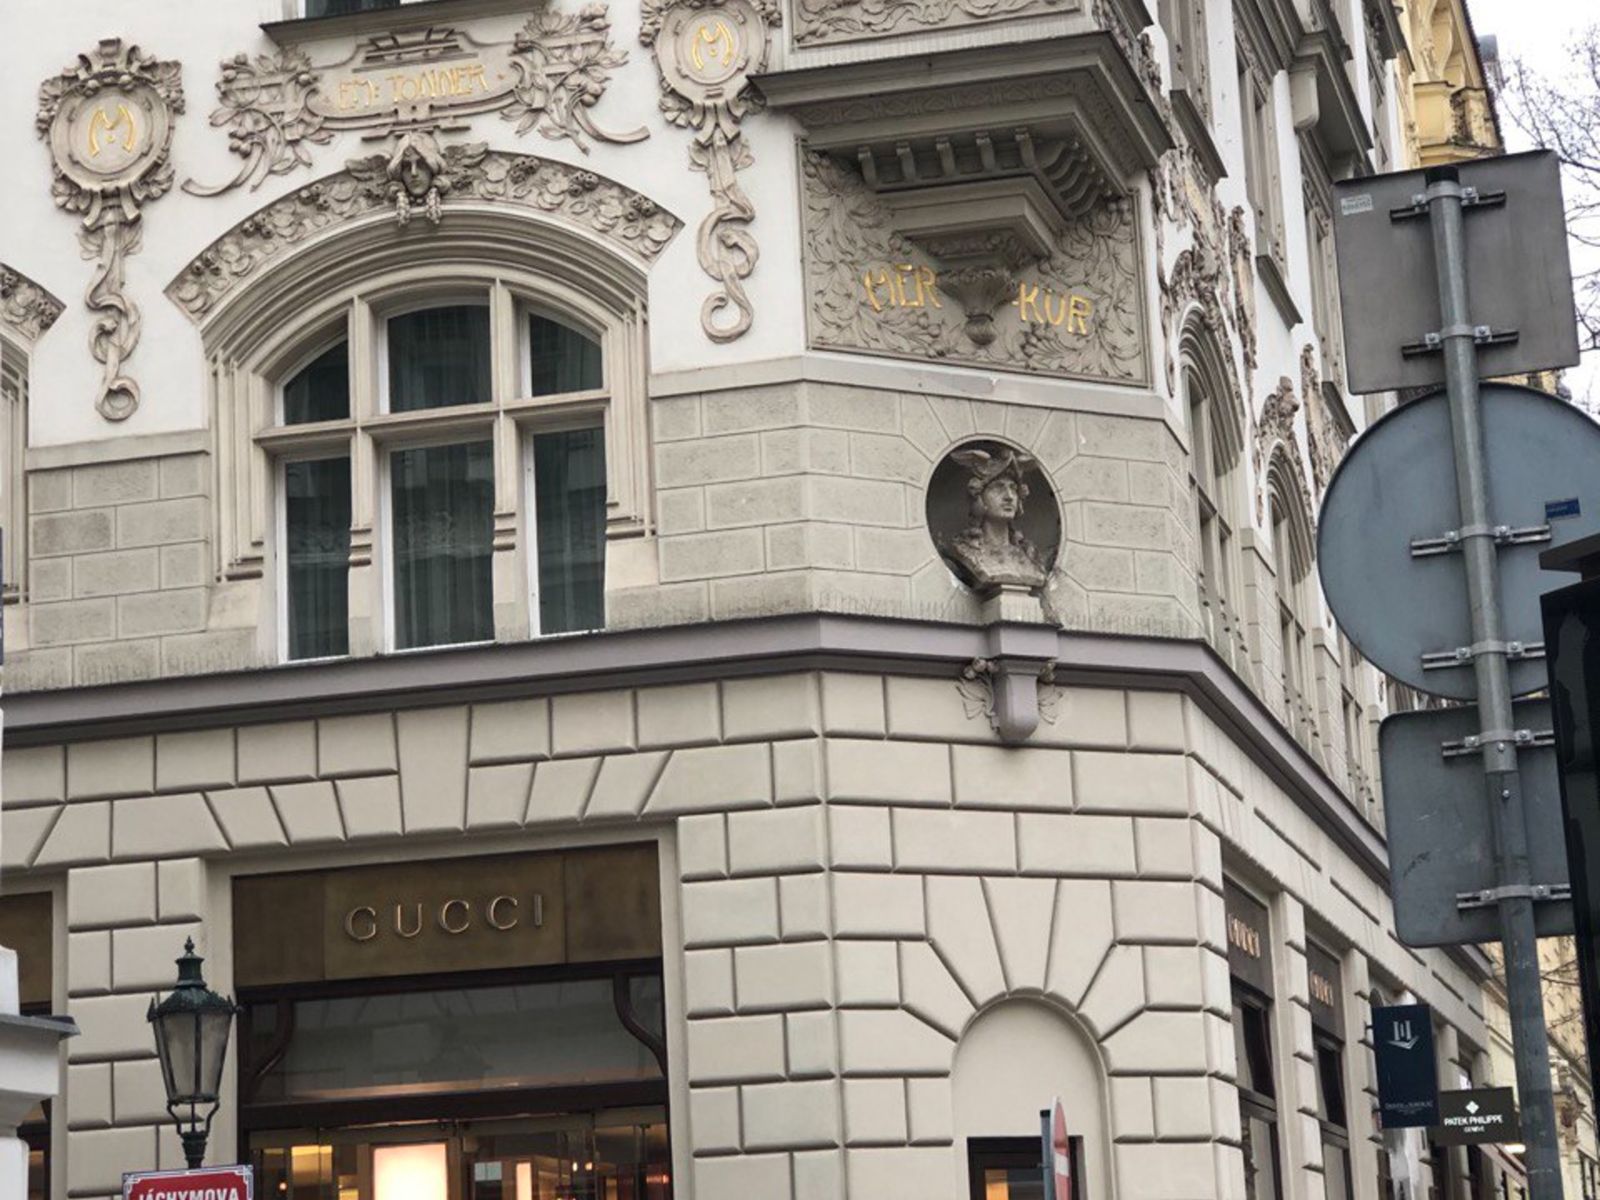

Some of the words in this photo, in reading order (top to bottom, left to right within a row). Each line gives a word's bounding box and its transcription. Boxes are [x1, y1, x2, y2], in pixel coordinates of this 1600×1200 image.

[386, 63, 489, 102] TONNER
[864, 264, 942, 313] MER
[344, 894, 543, 941] GUCCI
[1443, 1116, 1469, 1127] PATEK
[1469, 1114, 1503, 1125] PHILIPPE
